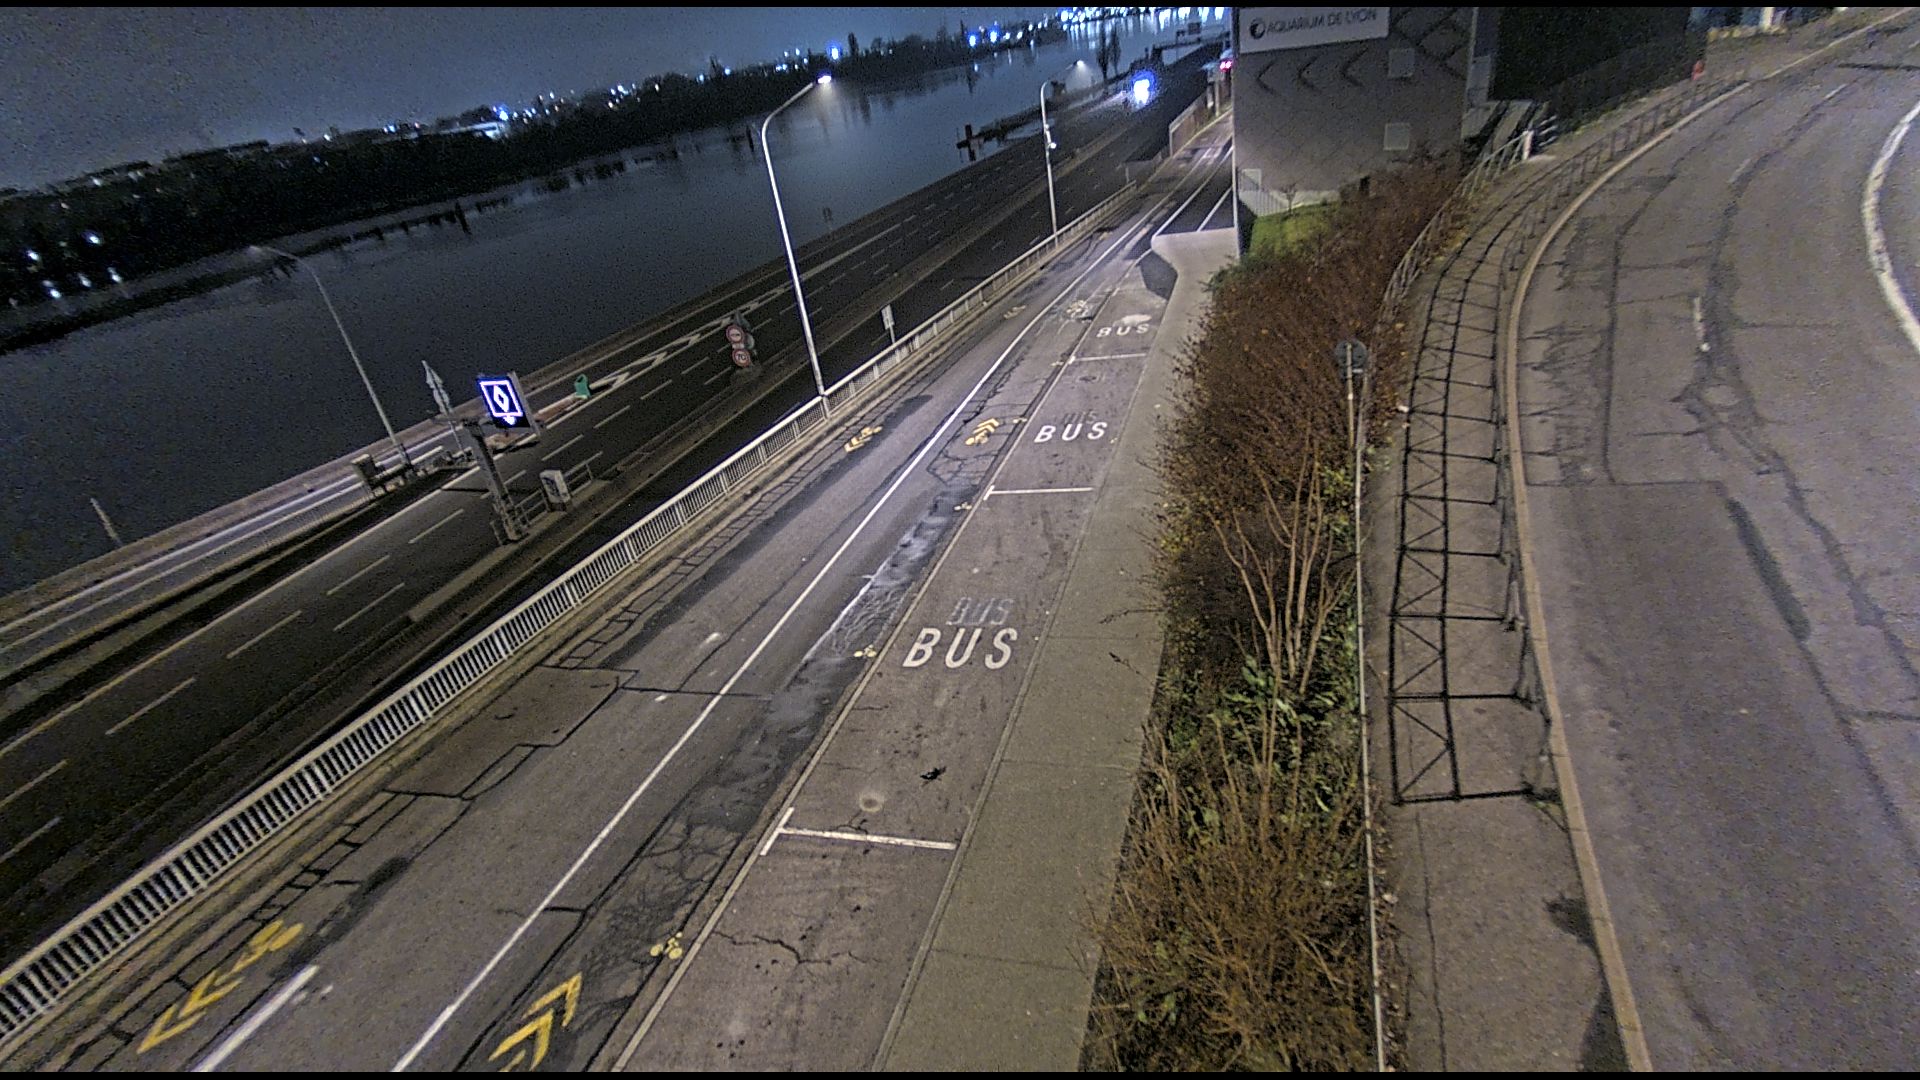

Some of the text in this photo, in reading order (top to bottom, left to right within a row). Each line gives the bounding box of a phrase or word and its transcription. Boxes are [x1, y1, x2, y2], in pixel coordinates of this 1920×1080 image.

[1267, 8, 1377, 34] AQUARIUM DE LYON
[1096, 323, 1150, 338] BUS
[1033, 421, 1108, 443] BUS
[902, 627, 1018, 670] BUS
